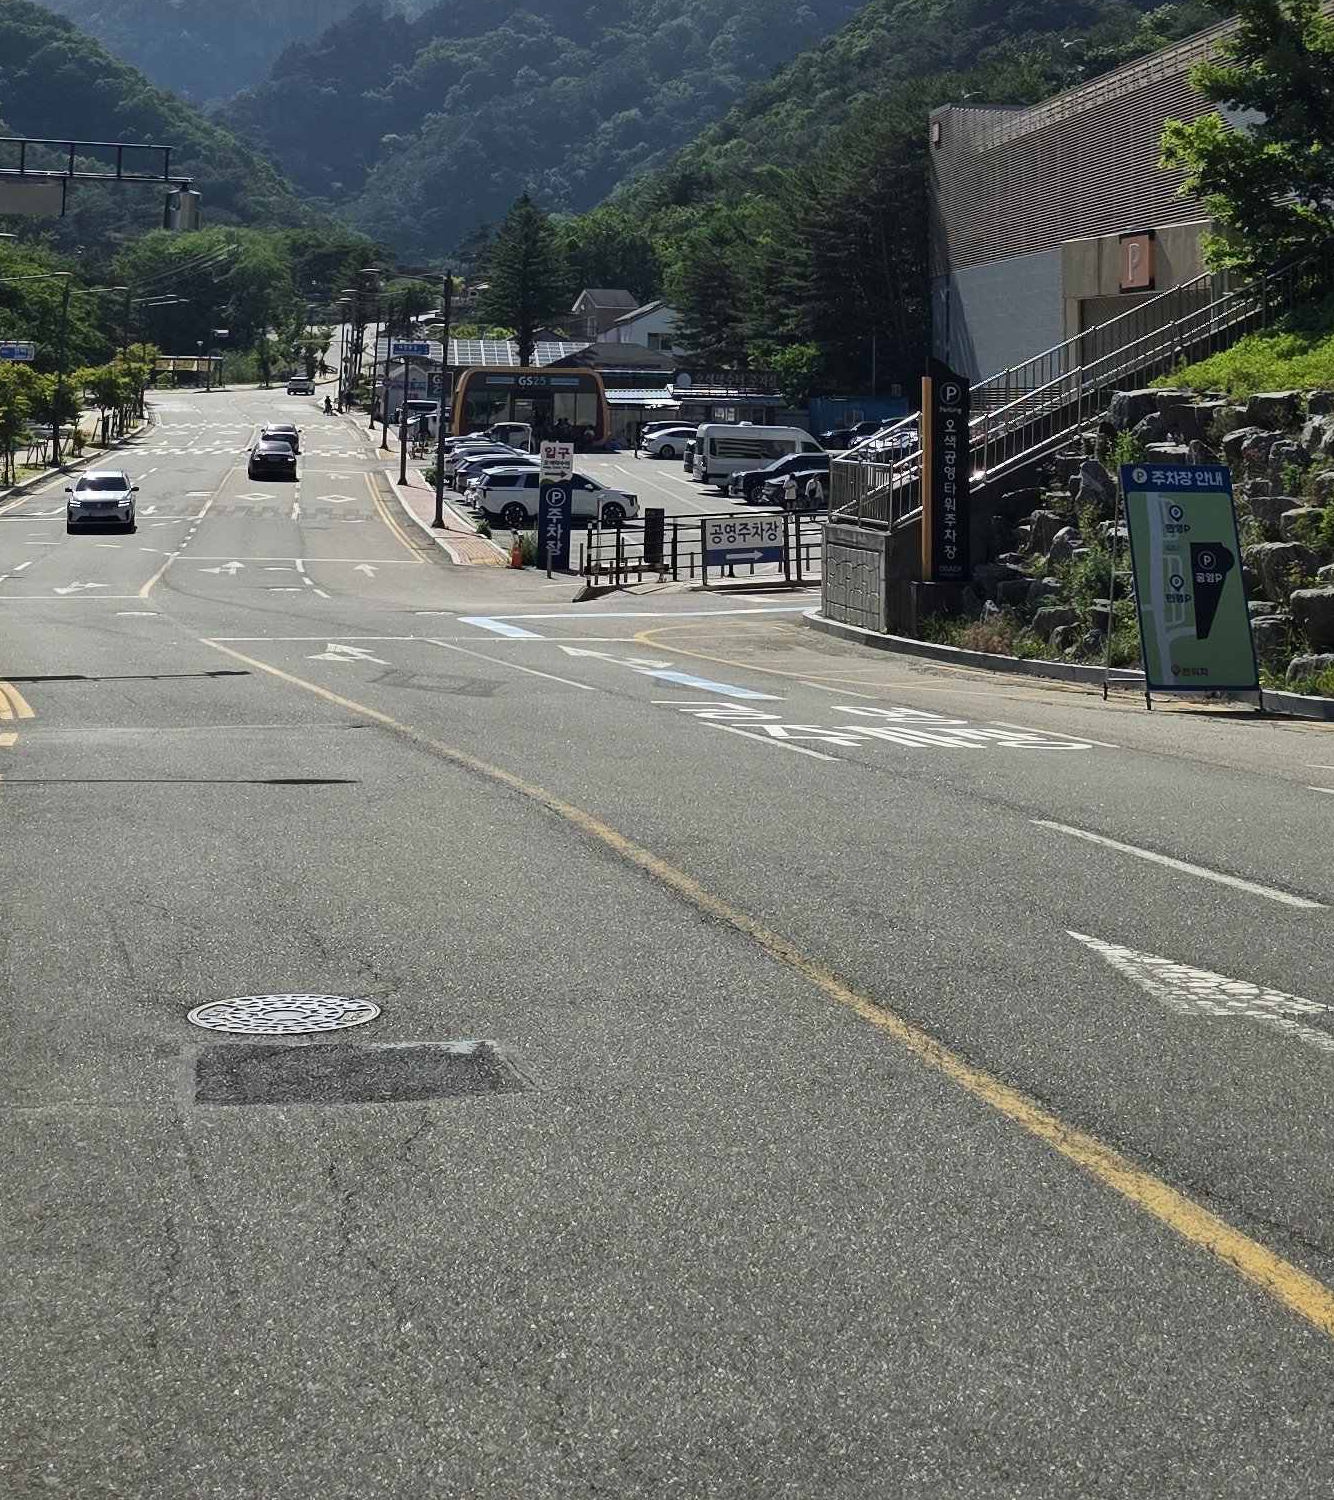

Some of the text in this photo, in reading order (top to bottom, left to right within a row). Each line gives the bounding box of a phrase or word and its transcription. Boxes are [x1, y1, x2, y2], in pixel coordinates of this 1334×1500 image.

[519, 376, 547, 386] GS25
[939, 406, 962, 414] Parking
[544, 447, 571, 459] 입구
[1151, 470, 1193, 486] 주차장
[1195, 471, 1224, 487] 안내
[546, 508, 564, 556] 주차장
[710, 521, 779, 544] 공영주차장
[1195, 572, 1223, 583] 공영P
[1182, 666, 1209, 677] 현위치
[731, 723, 1093, 750] 주차장
